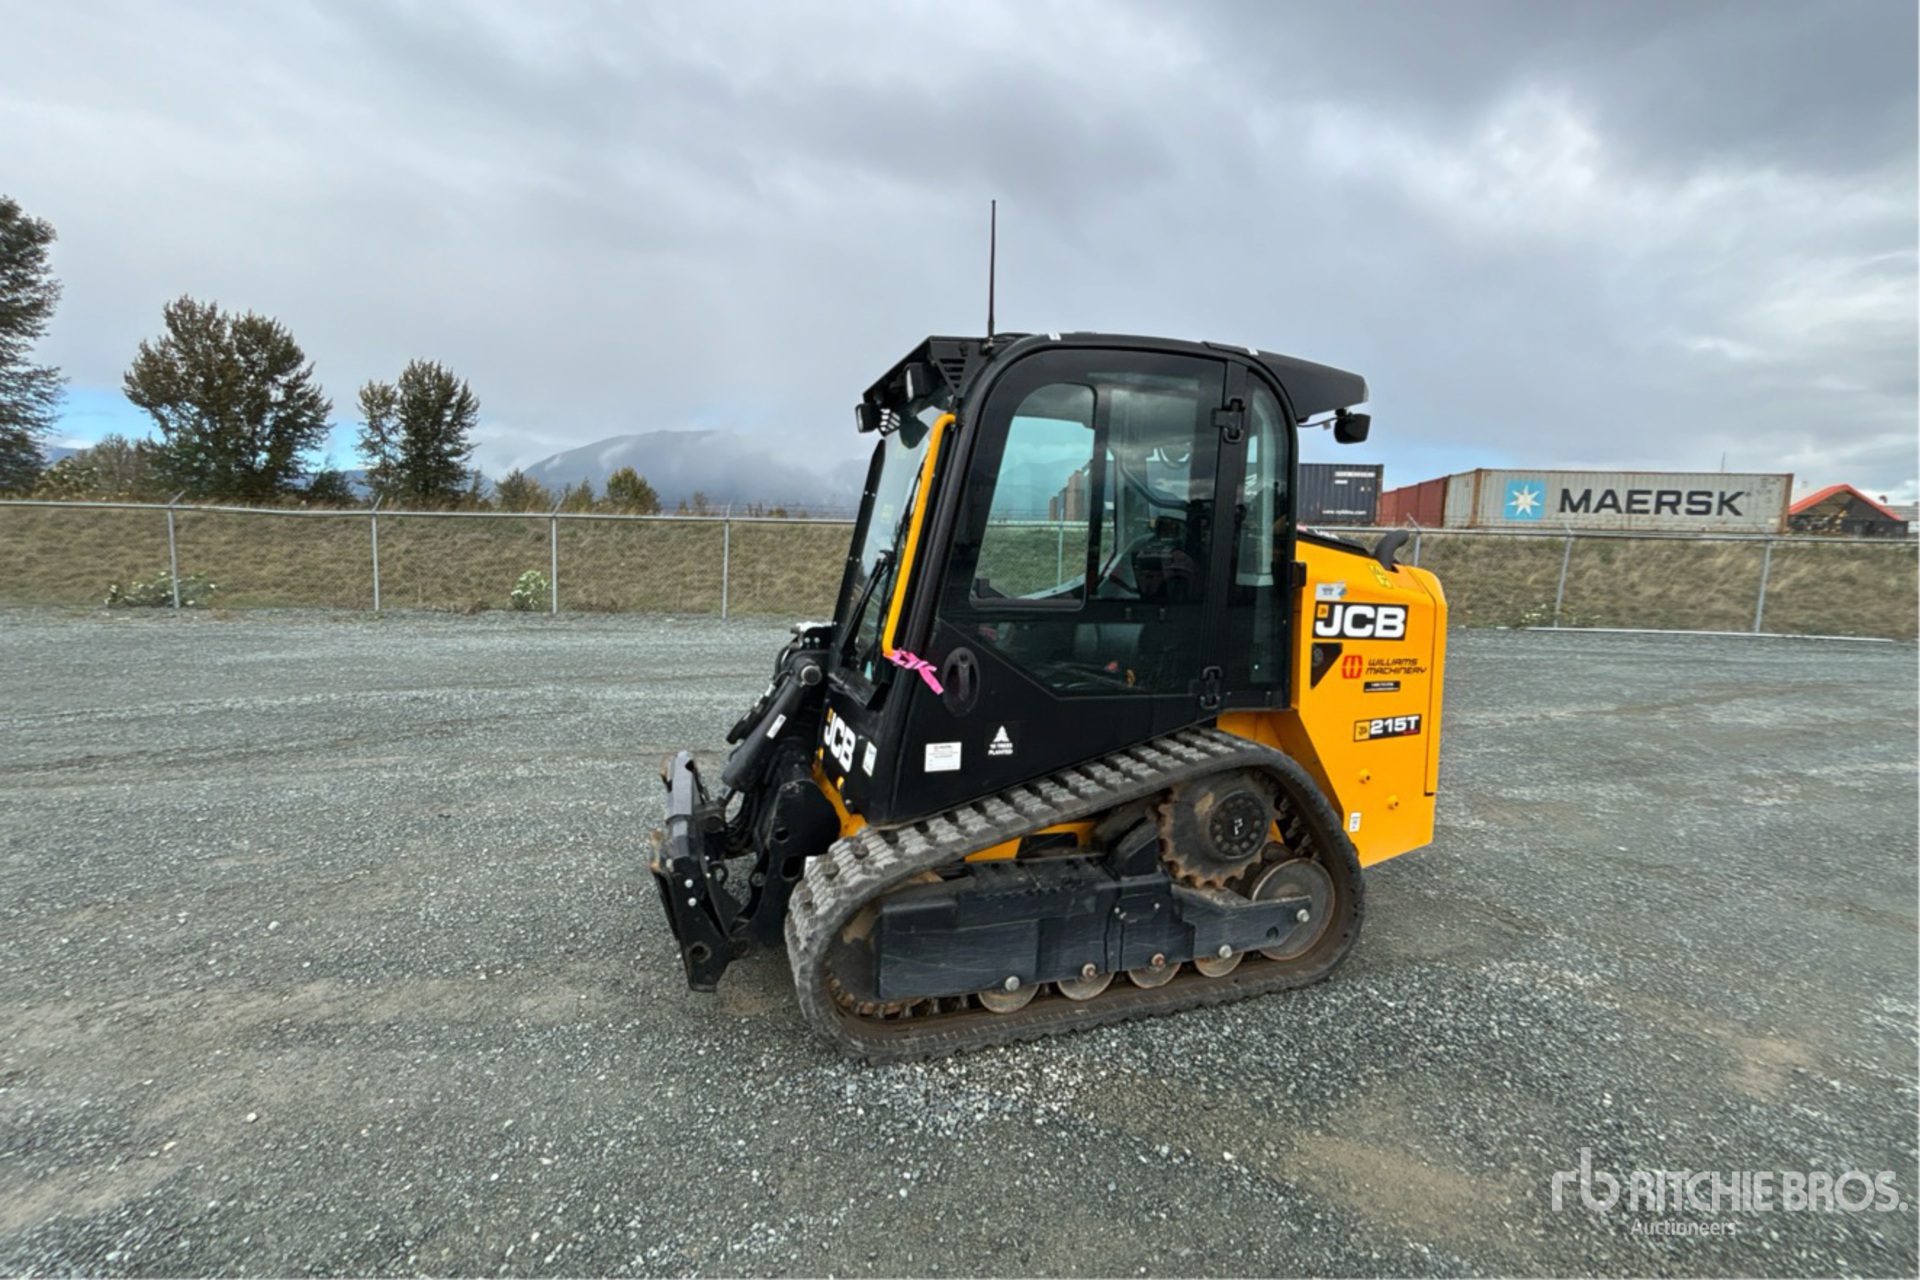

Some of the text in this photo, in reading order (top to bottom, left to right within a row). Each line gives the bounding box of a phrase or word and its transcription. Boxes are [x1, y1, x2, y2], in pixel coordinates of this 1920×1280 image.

[1559, 488, 1744, 516] MAERSK
[1315, 605, 1406, 638] JCB
[1365, 667, 1427, 675] MACHINERY
[1368, 658, 1418, 666] WILLIAMS
[1370, 715, 1420, 735] 215T
[824, 712, 856, 773] JCB
